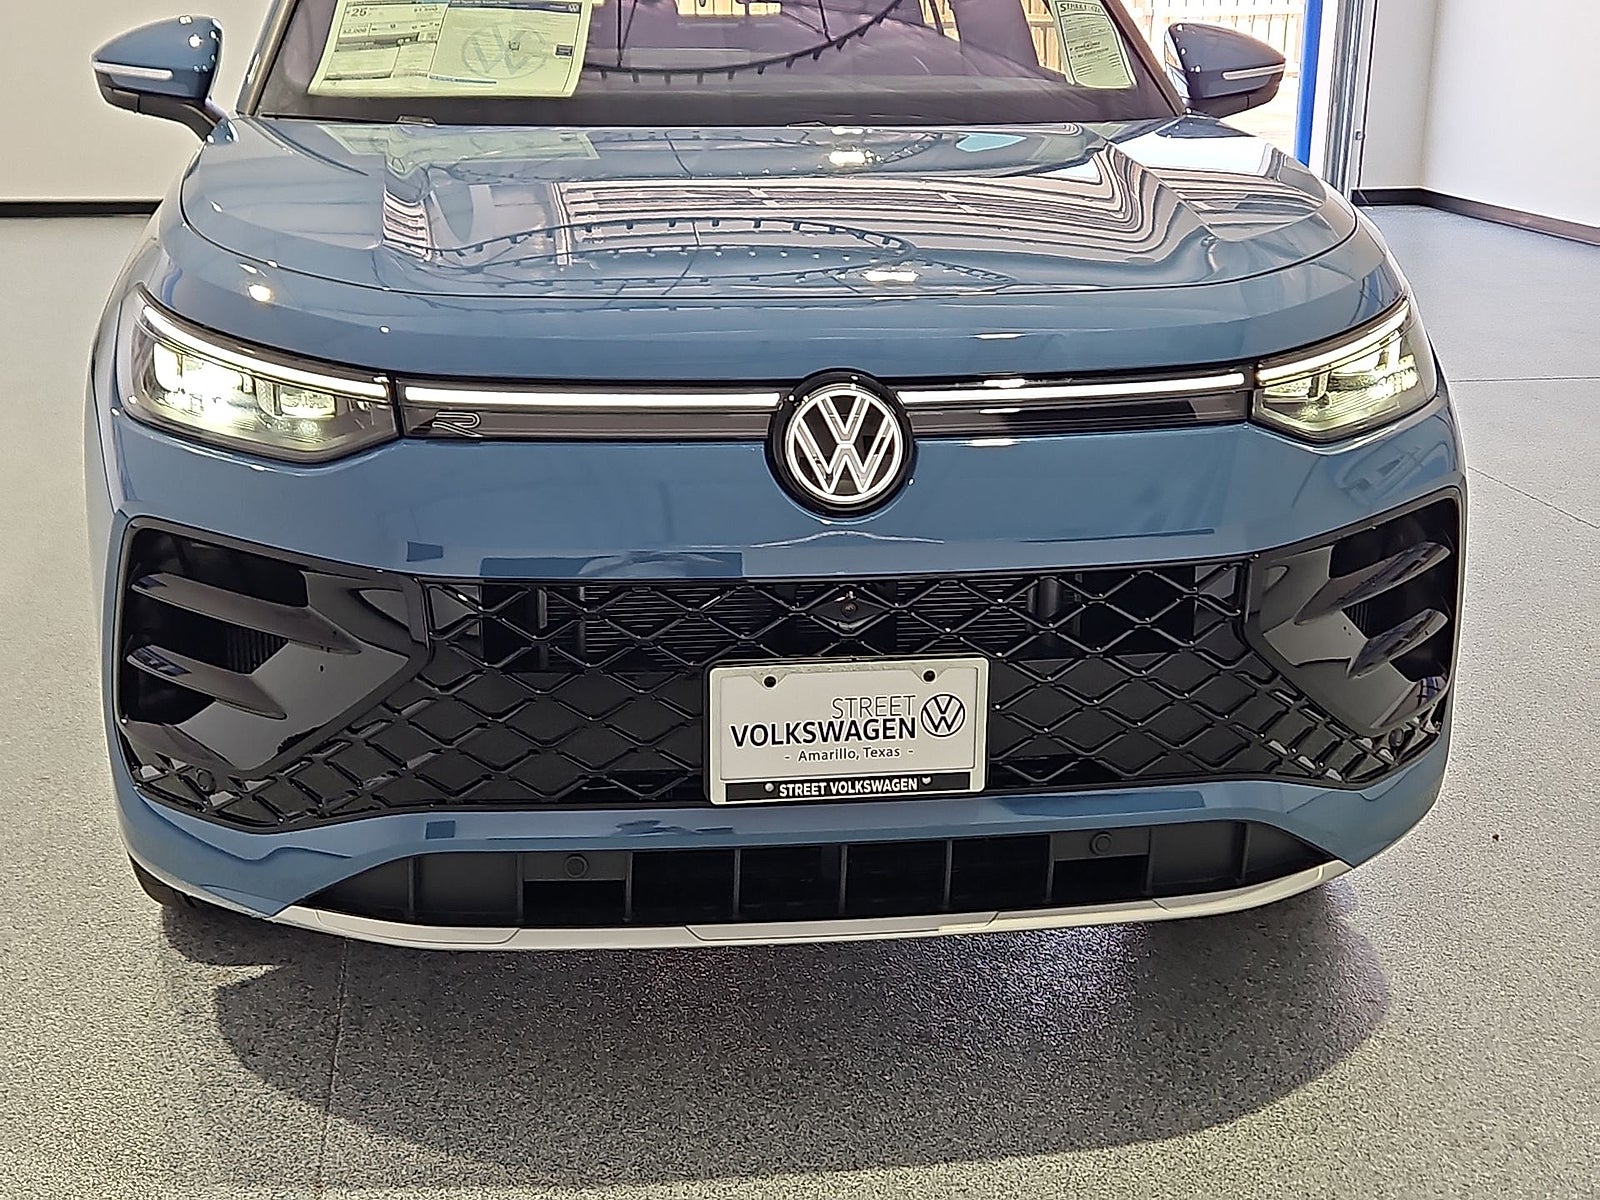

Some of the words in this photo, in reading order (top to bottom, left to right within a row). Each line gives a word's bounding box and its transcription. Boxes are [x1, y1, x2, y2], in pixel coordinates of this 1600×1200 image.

[350, 7, 368, 17] 25
[432, 411, 483, 437] R
[831, 695, 916, 720] STREET
[730, 717, 916, 747] VOLKSWAGEN
[798, 748, 860, 763] Amarillo,
[863, 747, 900, 759] Texas
[779, 781, 827, 797] STREET
[829, 777, 918, 795] VOLKSWAGEN
